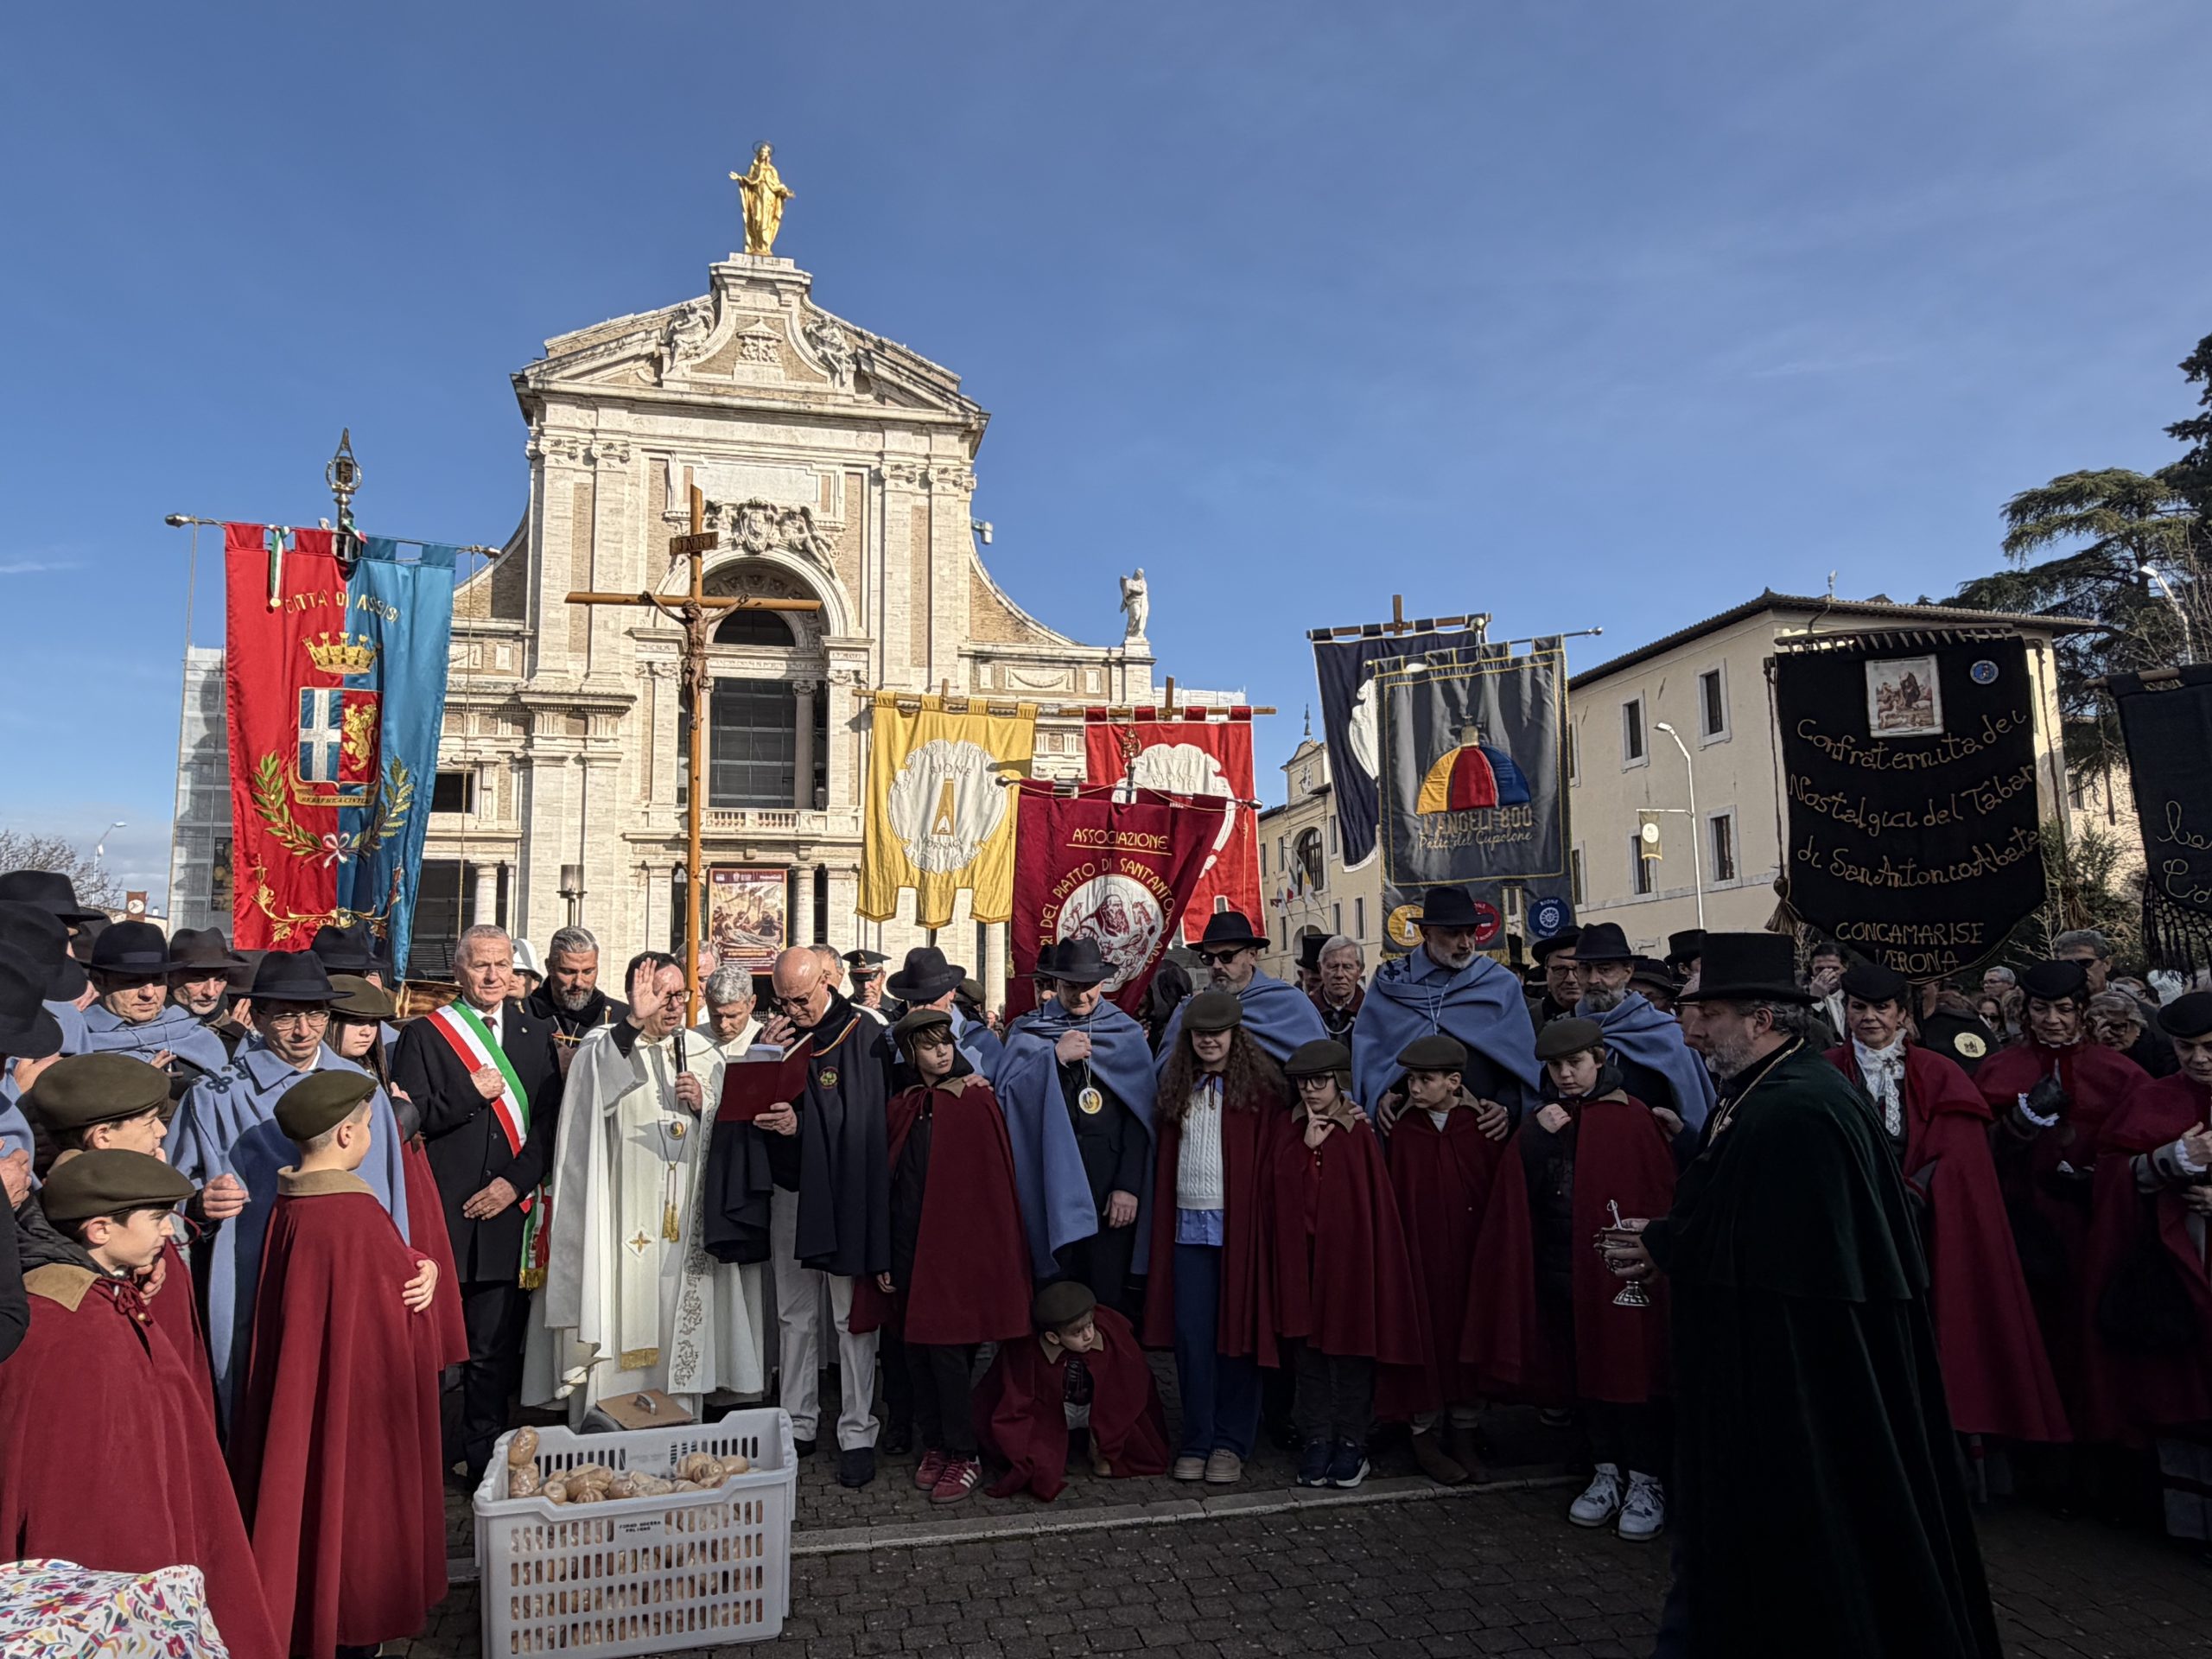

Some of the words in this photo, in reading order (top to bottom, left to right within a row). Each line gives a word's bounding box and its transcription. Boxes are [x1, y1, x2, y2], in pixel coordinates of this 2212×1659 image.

[335, 591, 350, 608] DI
[357, 594, 400, 623] ASSISI
[1797, 718, 1984, 770] Confraternita
[930, 762, 973, 778] RIONE
[1500, 804, 1533, 828] 800
[1789, 773, 1919, 837] Nostalgici
[1923, 793, 1964, 827] del
[1071, 827, 1169, 850] ASSOCIAZIONE
[1039, 903, 1059, 929] DEL
[1052, 862, 1096, 899] PIATTO
[1101, 858, 1112, 872] DI
[1835, 921, 1985, 946] CONCAMARISE
[1874, 948, 1960, 974] VERONA
